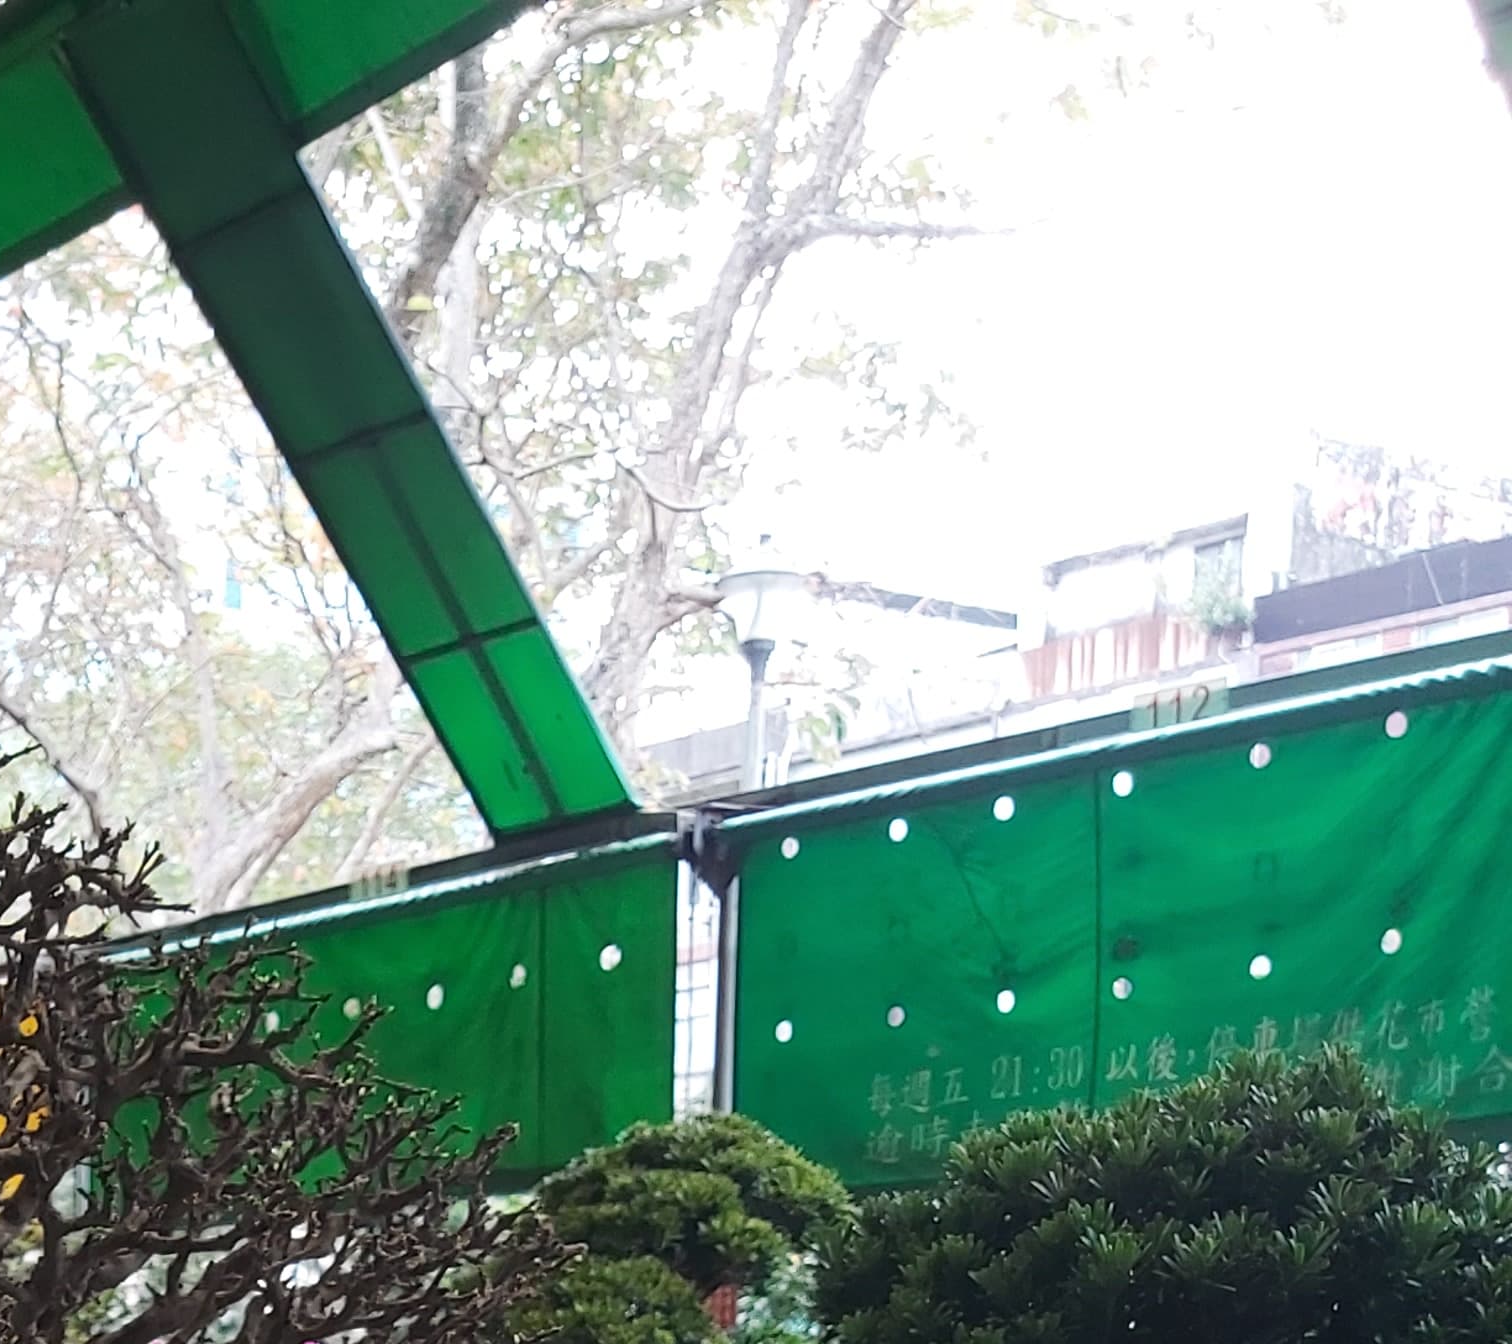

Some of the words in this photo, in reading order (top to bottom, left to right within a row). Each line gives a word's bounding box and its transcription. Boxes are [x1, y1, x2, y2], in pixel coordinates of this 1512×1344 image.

[1147, 684, 1209, 728] 112
[868, 1068, 968, 1118] 每週五
[990, 1046, 1085, 1100] 21:30
